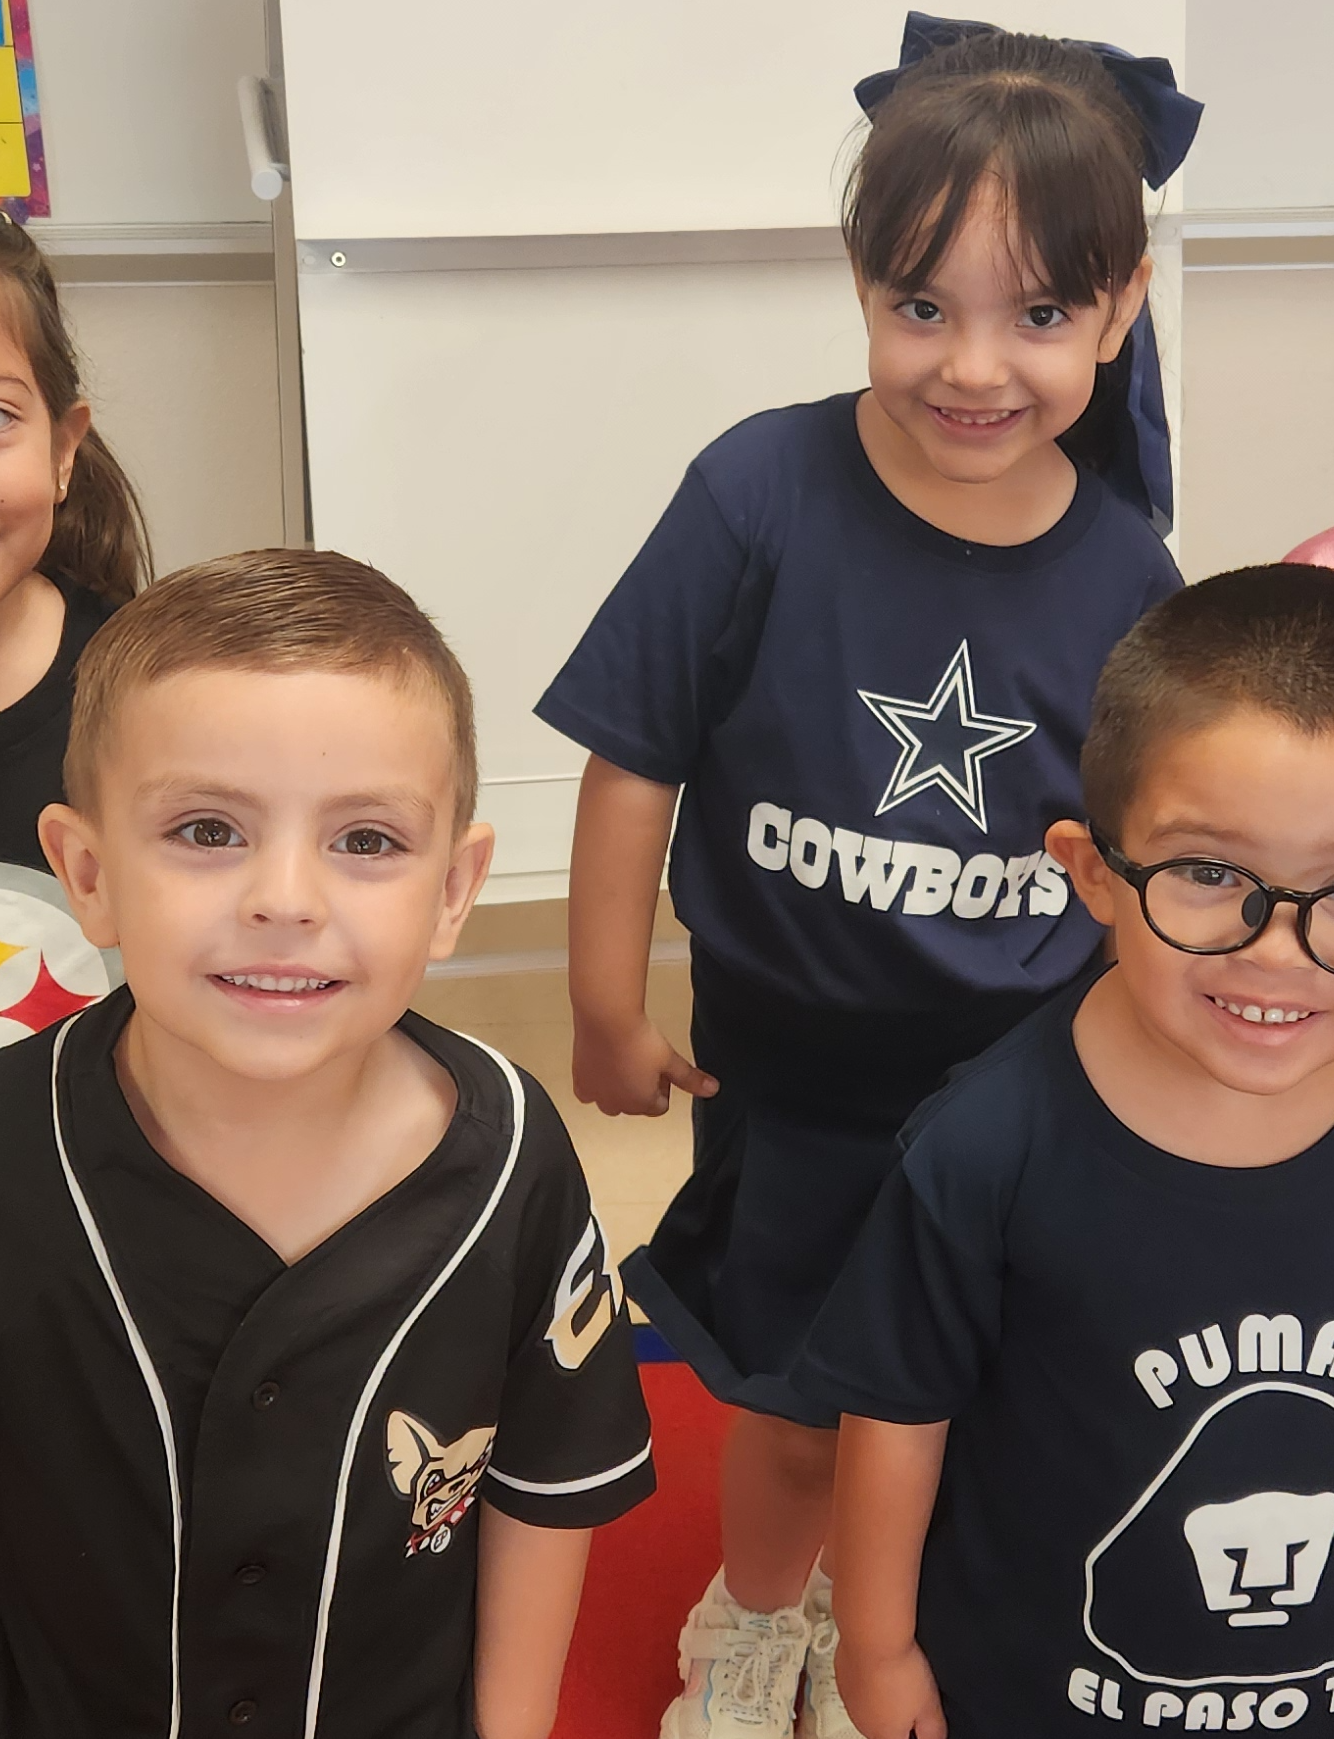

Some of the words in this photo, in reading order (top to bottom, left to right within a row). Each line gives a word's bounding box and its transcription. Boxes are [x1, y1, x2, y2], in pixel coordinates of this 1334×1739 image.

[747, 801, 1070, 920] COWBOYS
[1068, 1667, 1124, 1721] EL
[1142, 1687, 1309, 1731] PASO
